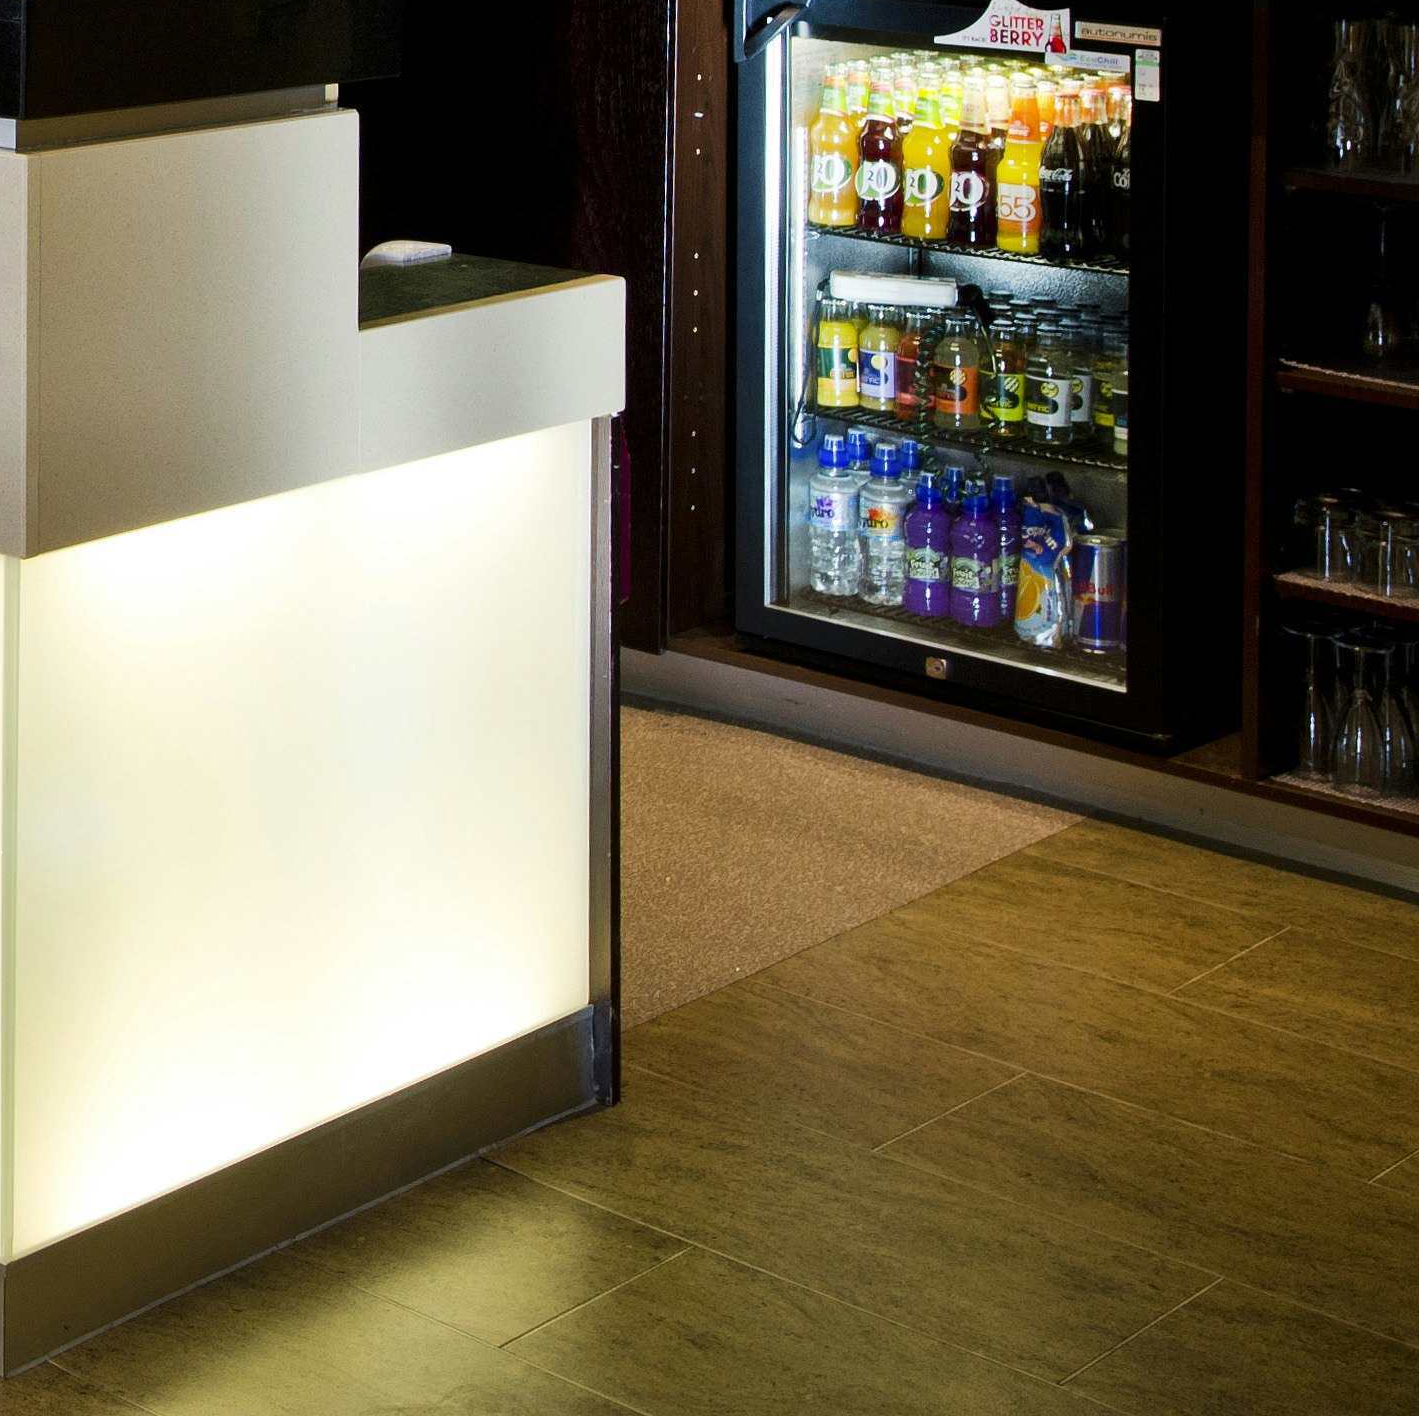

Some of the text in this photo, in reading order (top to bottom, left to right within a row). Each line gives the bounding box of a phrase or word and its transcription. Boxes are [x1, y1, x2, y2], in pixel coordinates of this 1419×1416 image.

[989, 15, 1044, 30] GLITTER
[989, 28, 1043, 47] BERRY
[1081, 27, 1158, 42] autonumis
[1079, 53, 1119, 65] EcoChill
[1000, 194, 1031, 219] 55
